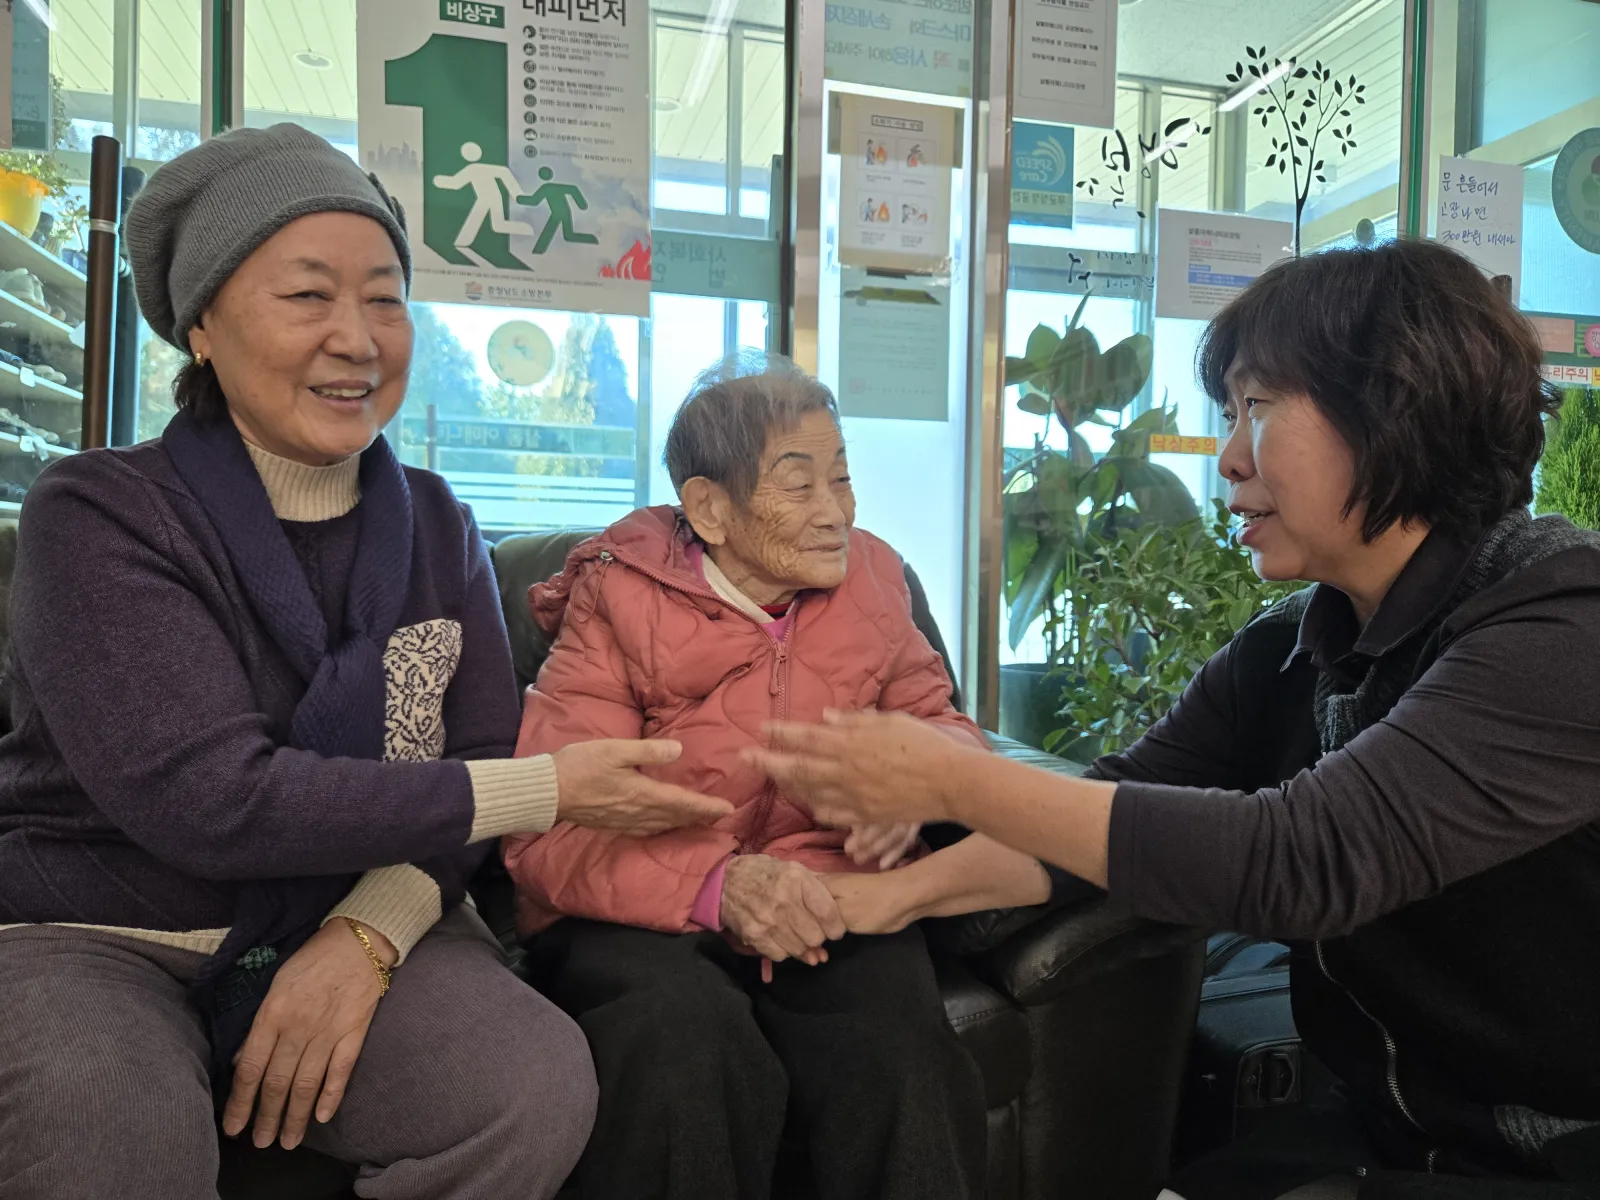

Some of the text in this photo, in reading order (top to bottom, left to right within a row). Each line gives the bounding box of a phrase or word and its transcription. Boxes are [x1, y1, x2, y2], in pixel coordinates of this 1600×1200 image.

[446, 3, 498, 25] 비상구
[1442, 172, 1499, 197] 문 흔들어서
[1153, 435, 1217, 454] 낙상주의
